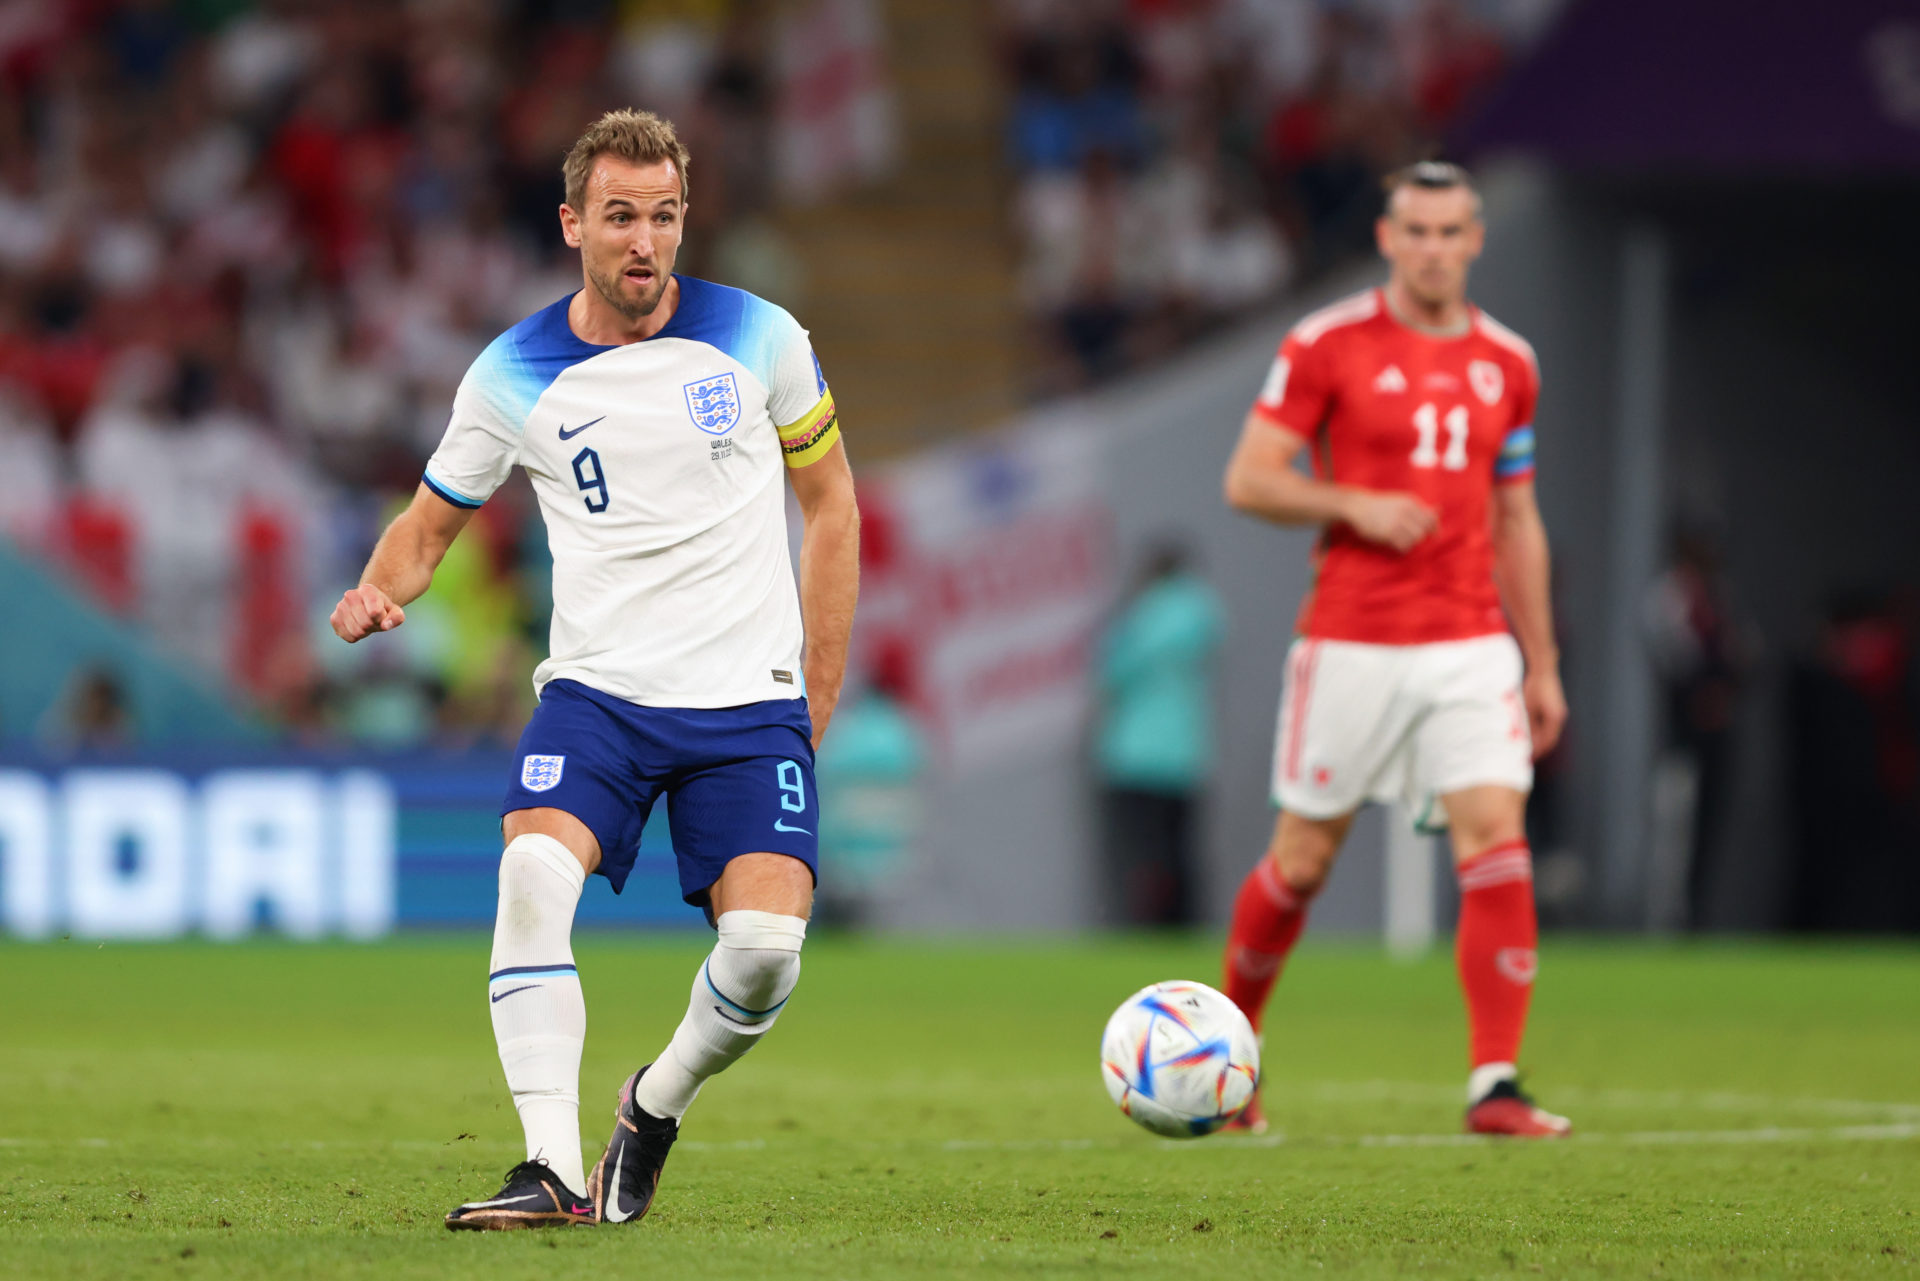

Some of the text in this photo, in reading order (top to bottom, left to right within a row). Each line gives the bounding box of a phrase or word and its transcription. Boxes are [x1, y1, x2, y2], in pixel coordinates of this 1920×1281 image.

[710, 437, 733, 449] WALES
[1409, 402, 1469, 471] 11
[571, 445, 610, 514] 9
[776, 759, 806, 814] 9
